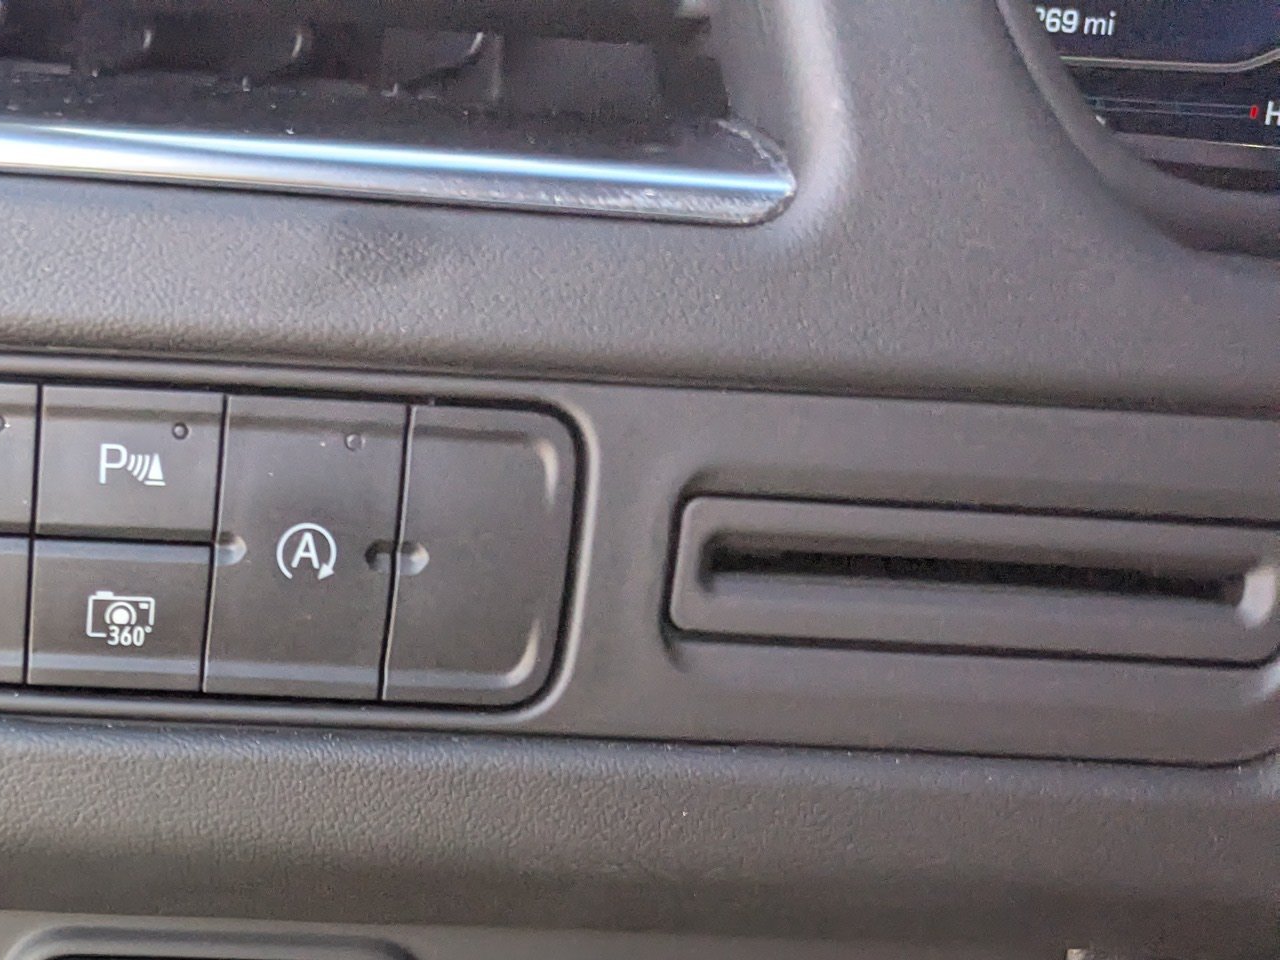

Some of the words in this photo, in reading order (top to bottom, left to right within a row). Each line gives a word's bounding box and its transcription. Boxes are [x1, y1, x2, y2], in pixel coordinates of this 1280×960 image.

[1083, 10, 1117, 36] mi
[98, 443, 128, 485] P
[290, 531, 321, 570] A
